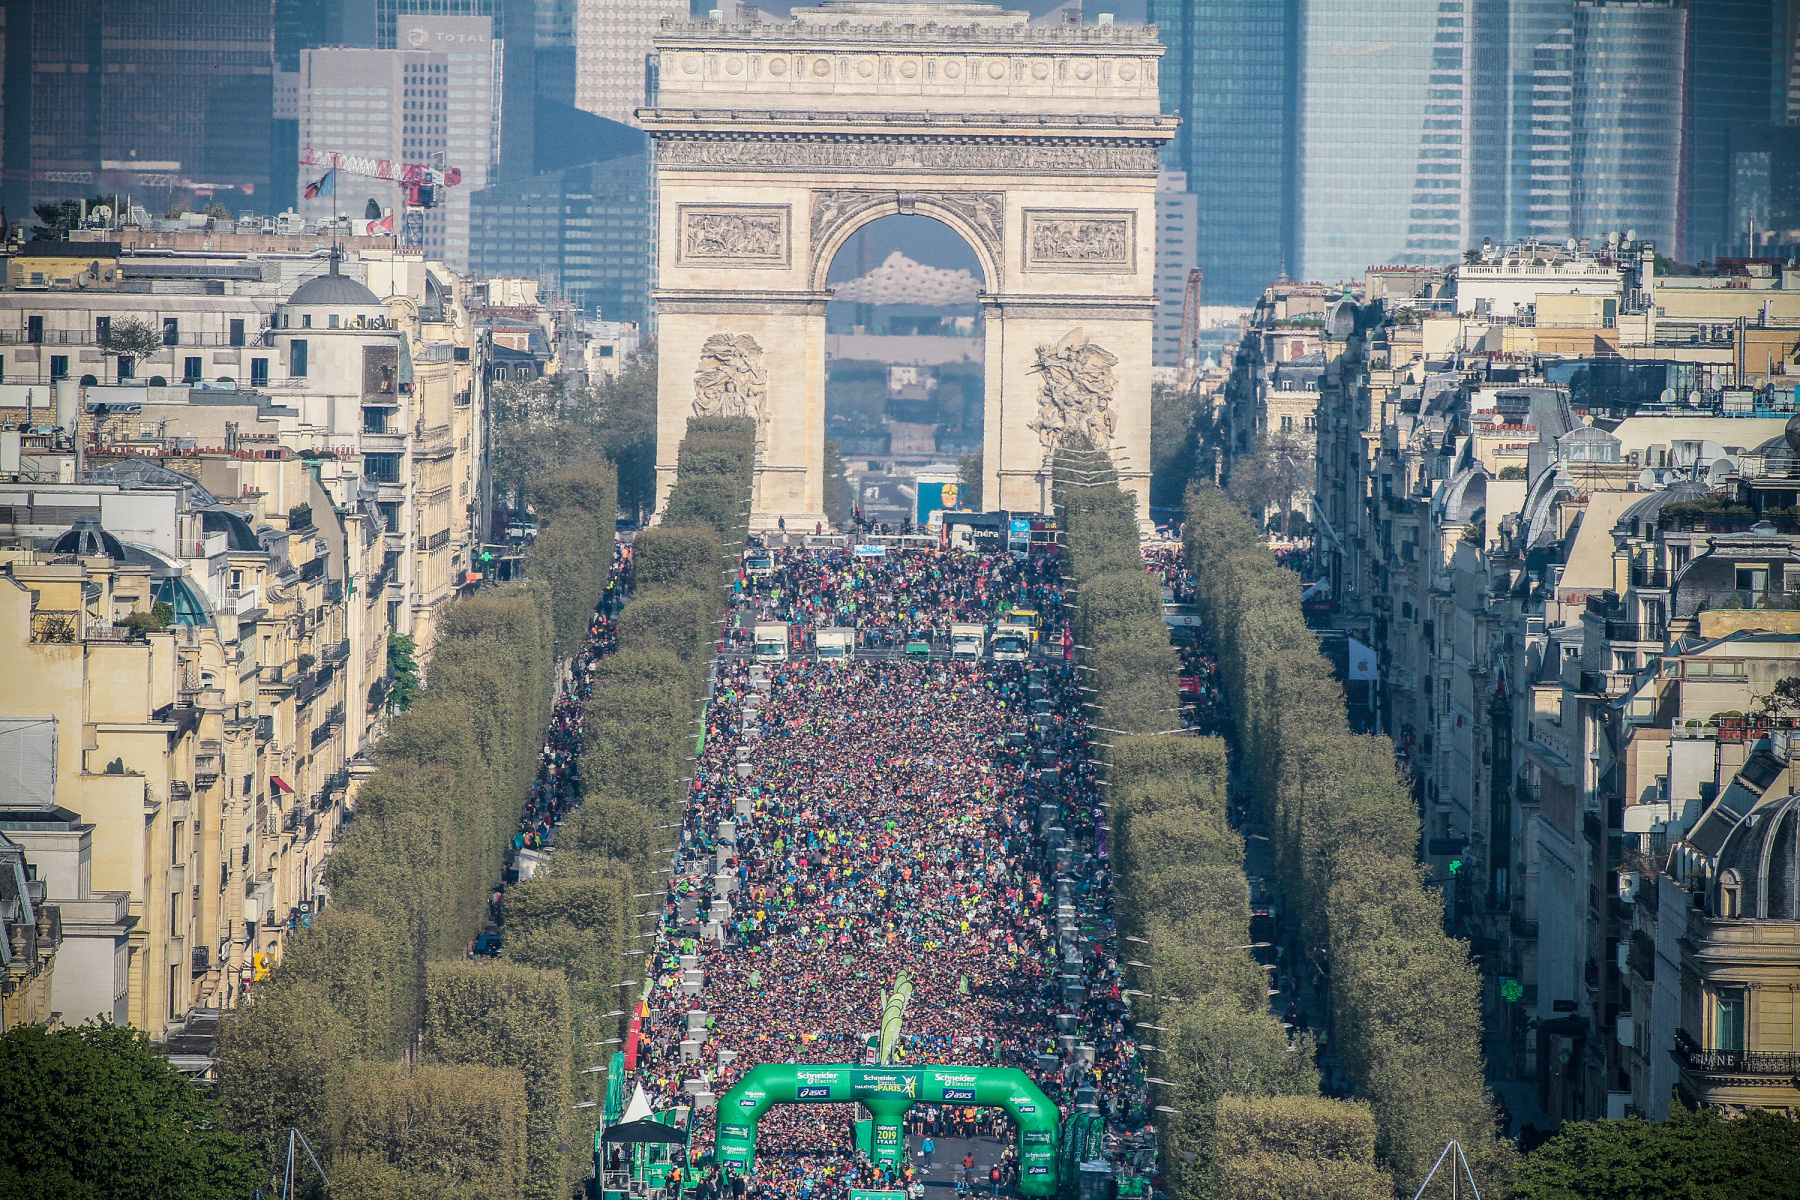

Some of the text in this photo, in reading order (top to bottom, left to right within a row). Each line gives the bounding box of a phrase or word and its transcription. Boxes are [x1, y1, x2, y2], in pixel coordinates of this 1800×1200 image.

[435, 32, 486, 43] TOTAL
[1690, 1053, 1735, 1067] ORLANE
[797, 1071, 839, 1080] Schneider
[934, 1073, 977, 1082] Schneider
[877, 1131, 897, 1140] 2019
